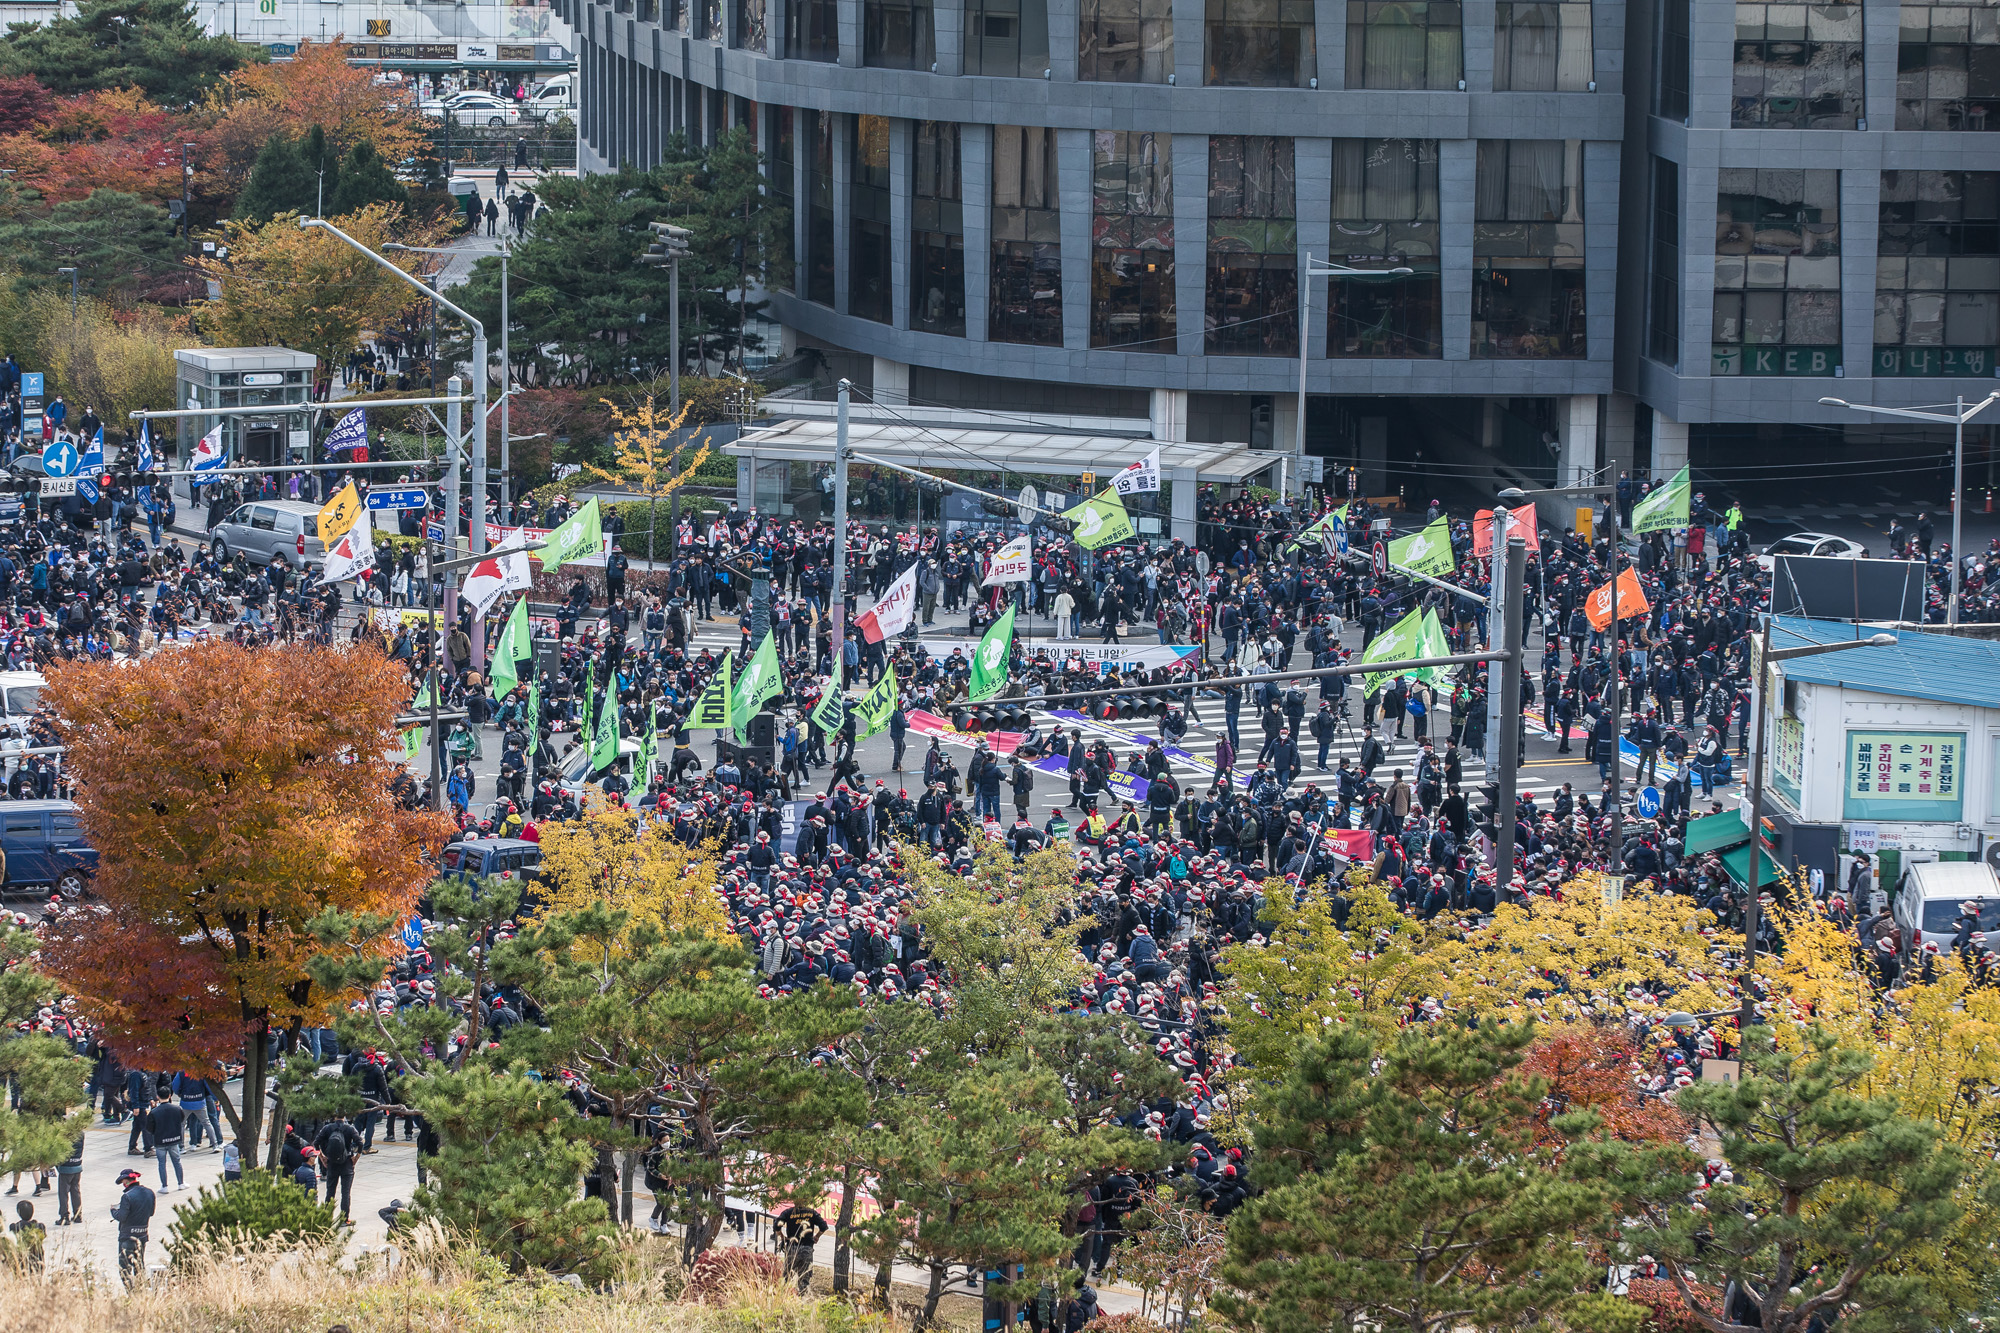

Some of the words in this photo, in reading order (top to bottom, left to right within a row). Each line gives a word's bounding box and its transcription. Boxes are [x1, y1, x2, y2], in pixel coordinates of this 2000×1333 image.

[1756, 351, 1827, 372] KEB
[1881, 350, 1985, 374] 하나은행
[42, 482, 75, 493] 동시신호
[1084, 486, 1090, 494] 9
[389, 493, 404, 501] 종로
[1375, 550, 1383, 565] 50
[1099, 648, 1119, 660] 내일
[1918, 744, 1933, 794] 기계주름
[1853, 840, 1875, 849] 주차장
